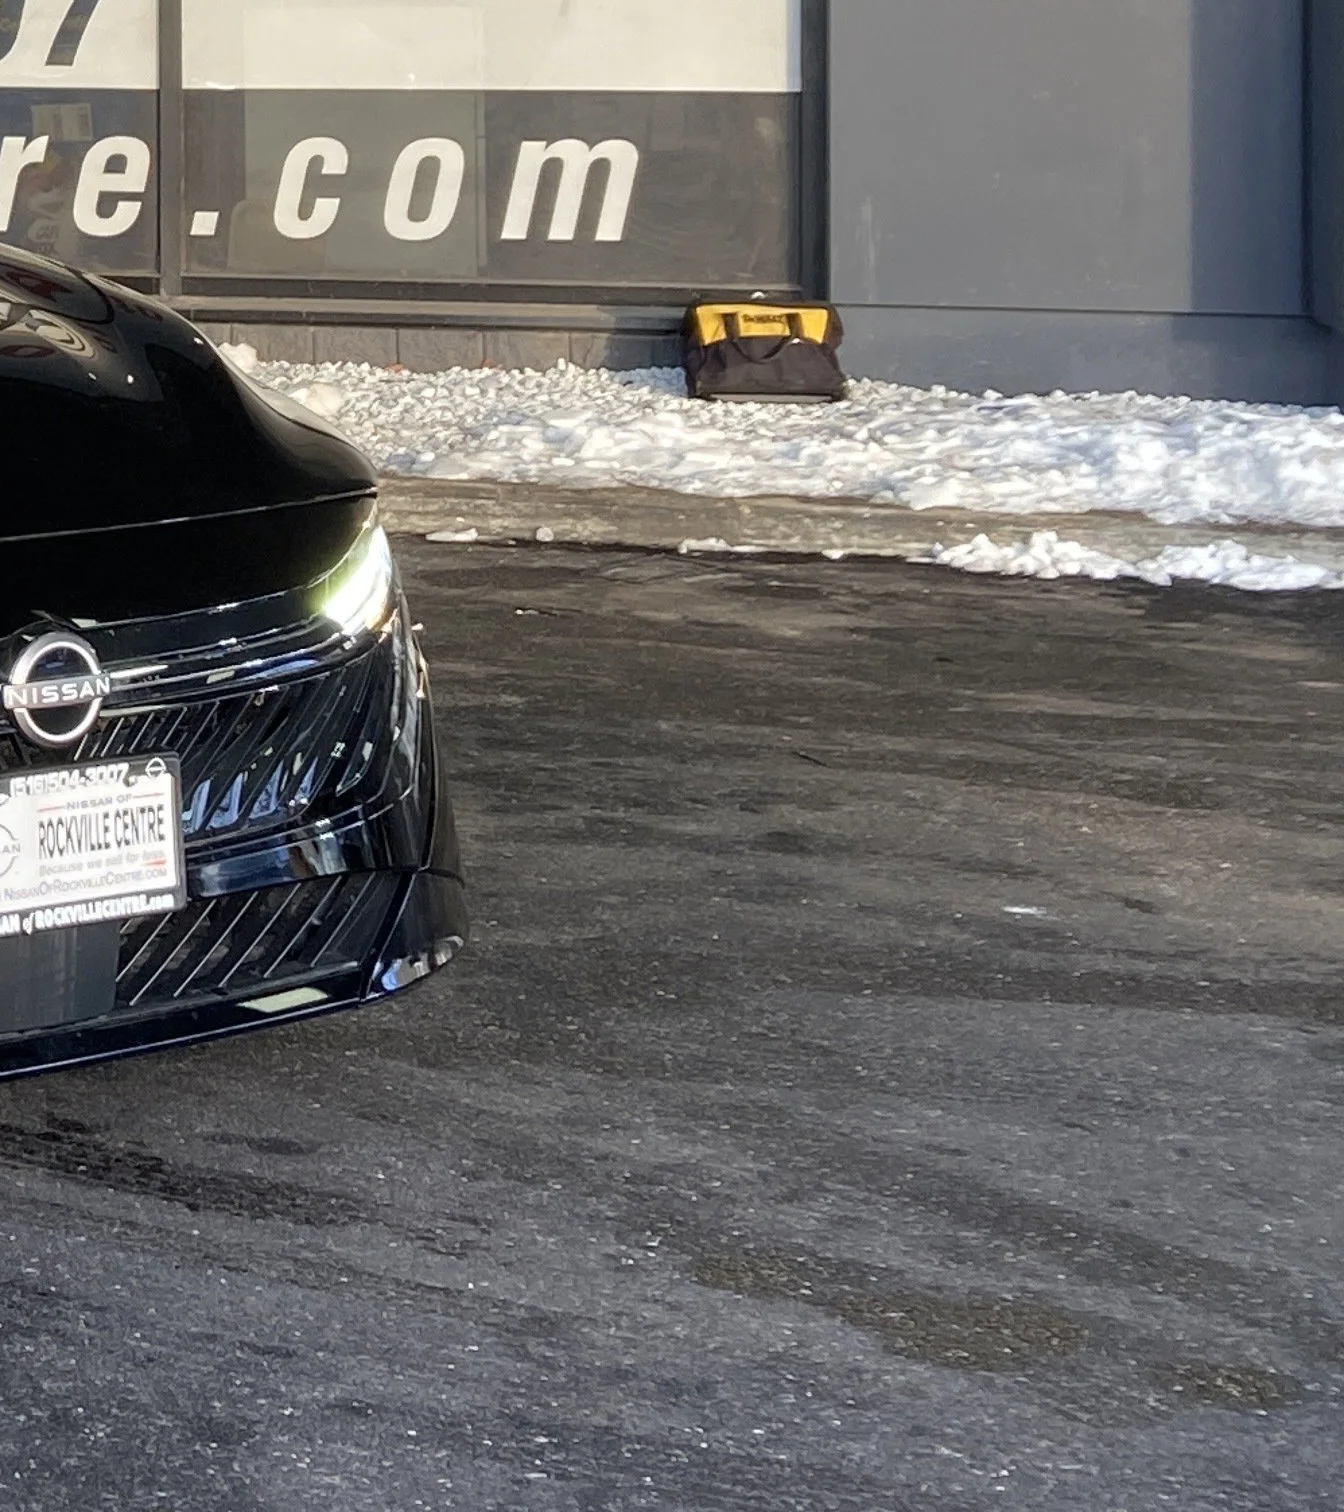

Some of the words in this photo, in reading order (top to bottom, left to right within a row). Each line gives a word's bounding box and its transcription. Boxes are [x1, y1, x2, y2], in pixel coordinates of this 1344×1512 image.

[8, 676, 110, 706] NISSAN
[66, 797, 113, 811] NISSAN
[116, 793, 133, 804] OF
[39, 812, 112, 861] ROCKVILLE
[114, 803, 167, 849] CENTRE
[23, 911, 36, 936] of
